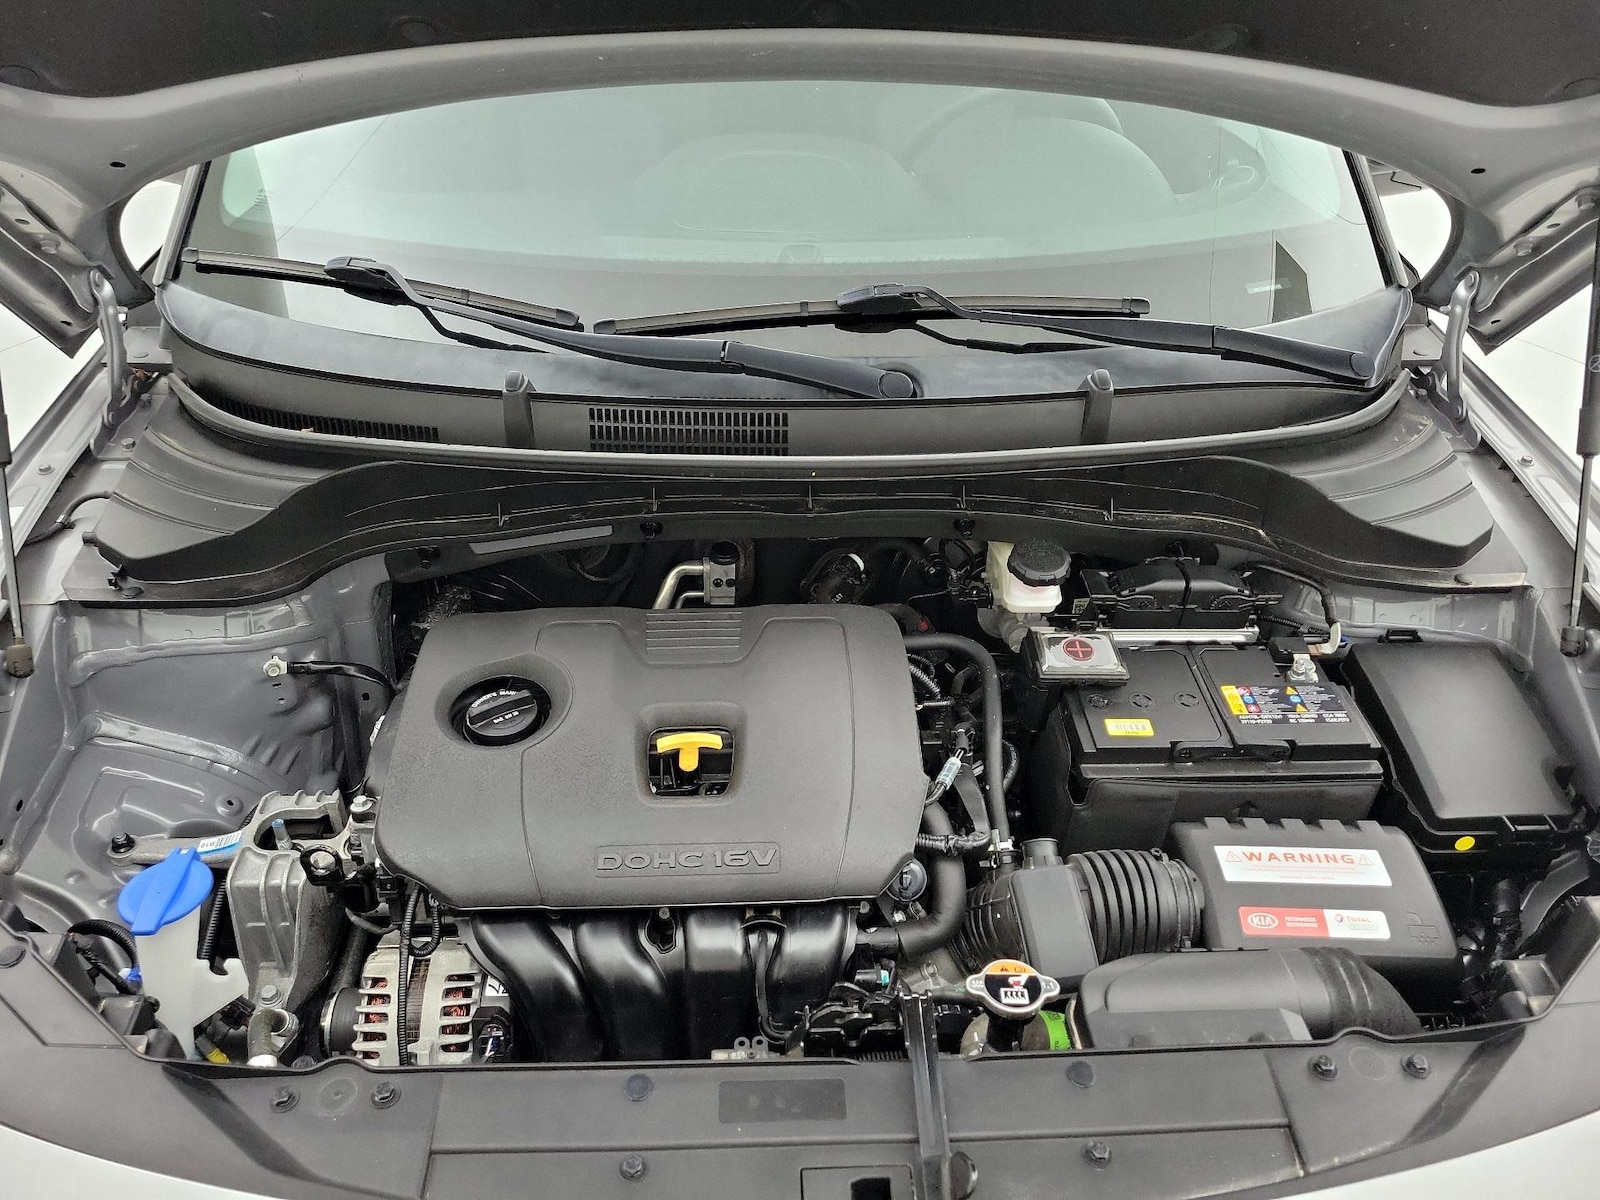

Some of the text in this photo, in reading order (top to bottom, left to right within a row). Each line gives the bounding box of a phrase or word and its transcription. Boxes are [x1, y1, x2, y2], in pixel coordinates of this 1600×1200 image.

[597, 849, 777, 871] DOHC 16V
[1242, 851, 1356, 864] WARNING
[1345, 915, 1373, 923] TOTAL
